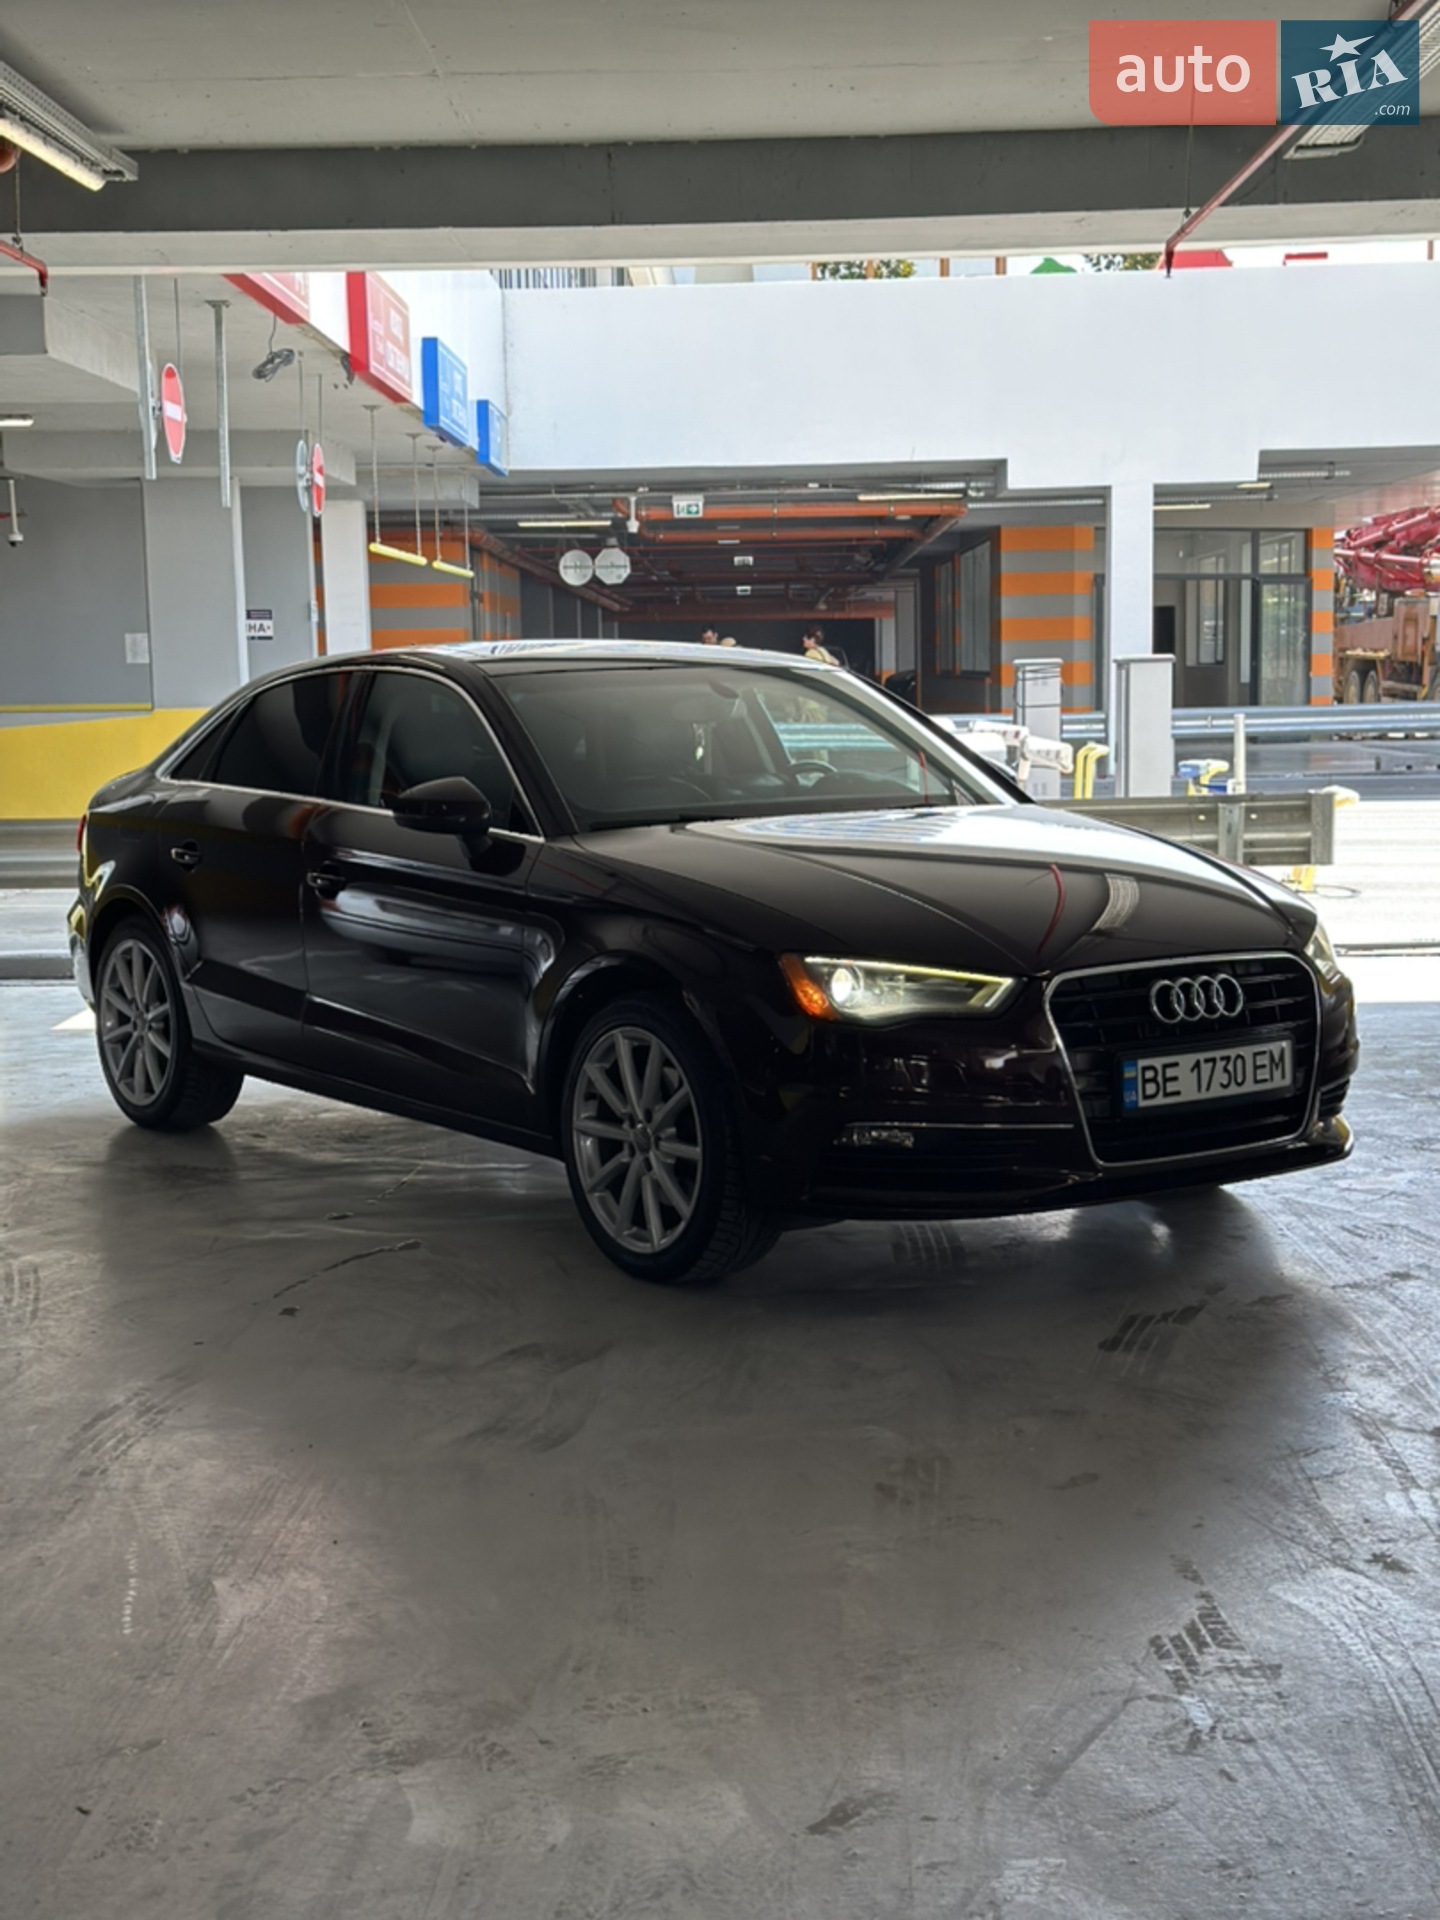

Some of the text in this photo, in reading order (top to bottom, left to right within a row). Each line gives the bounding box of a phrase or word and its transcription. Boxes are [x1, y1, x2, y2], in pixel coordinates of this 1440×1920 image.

[1140, 1047, 1286, 1101] BE 1730 EM
